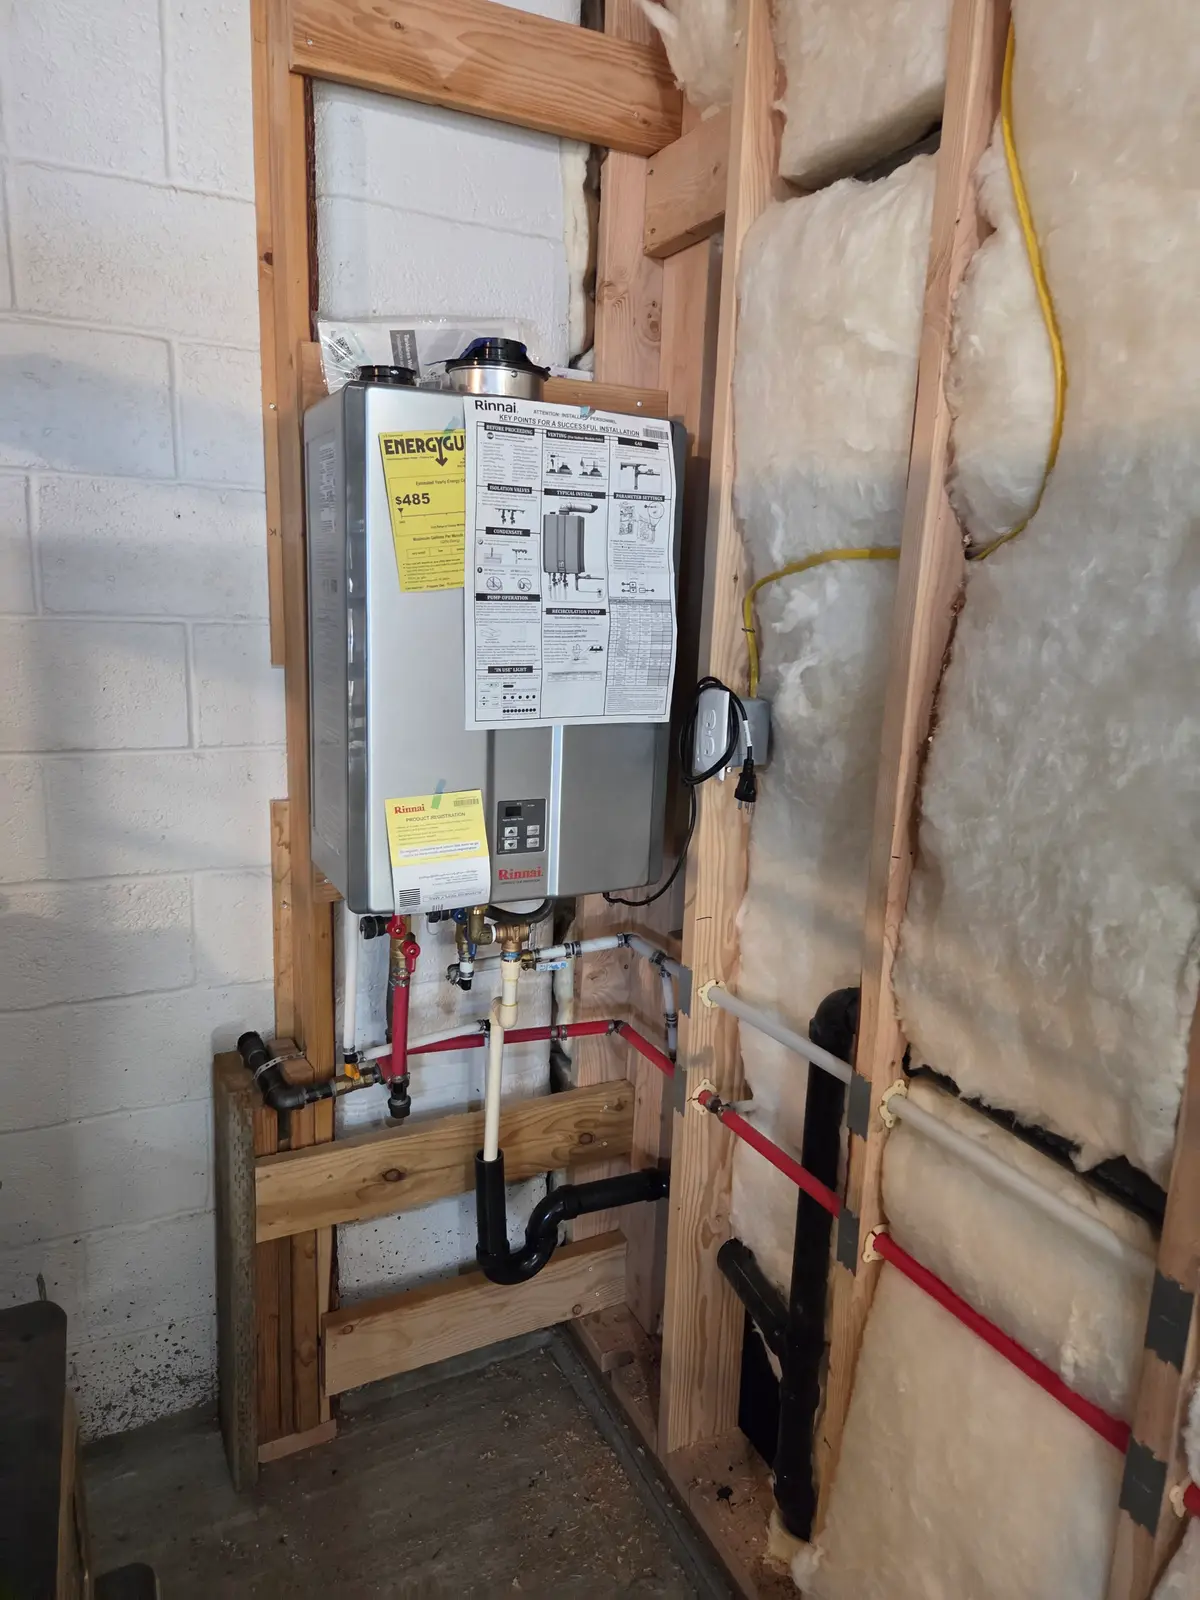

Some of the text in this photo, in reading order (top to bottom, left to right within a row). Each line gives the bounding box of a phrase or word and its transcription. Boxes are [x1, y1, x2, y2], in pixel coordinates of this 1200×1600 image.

[475, 400, 516, 413] Rinnai
[505, 426, 533, 435] PROCEEDING
[514, 416, 536, 425] POINTS
[538, 418, 551, 426] FOR
[557, 420, 598, 431] SUCCESSFUL
[599, 425, 640, 437] INSTALLATION
[384, 435, 464, 458] ENERGYGU
[395, 493, 430, 506] $485
[493, 528, 523, 536] CONDENSATE
[394, 804, 426, 815] Rinnai
[406, 812, 466, 823] PRODUCT REGISTRATION
[498, 865, 543, 880] Rinnai
